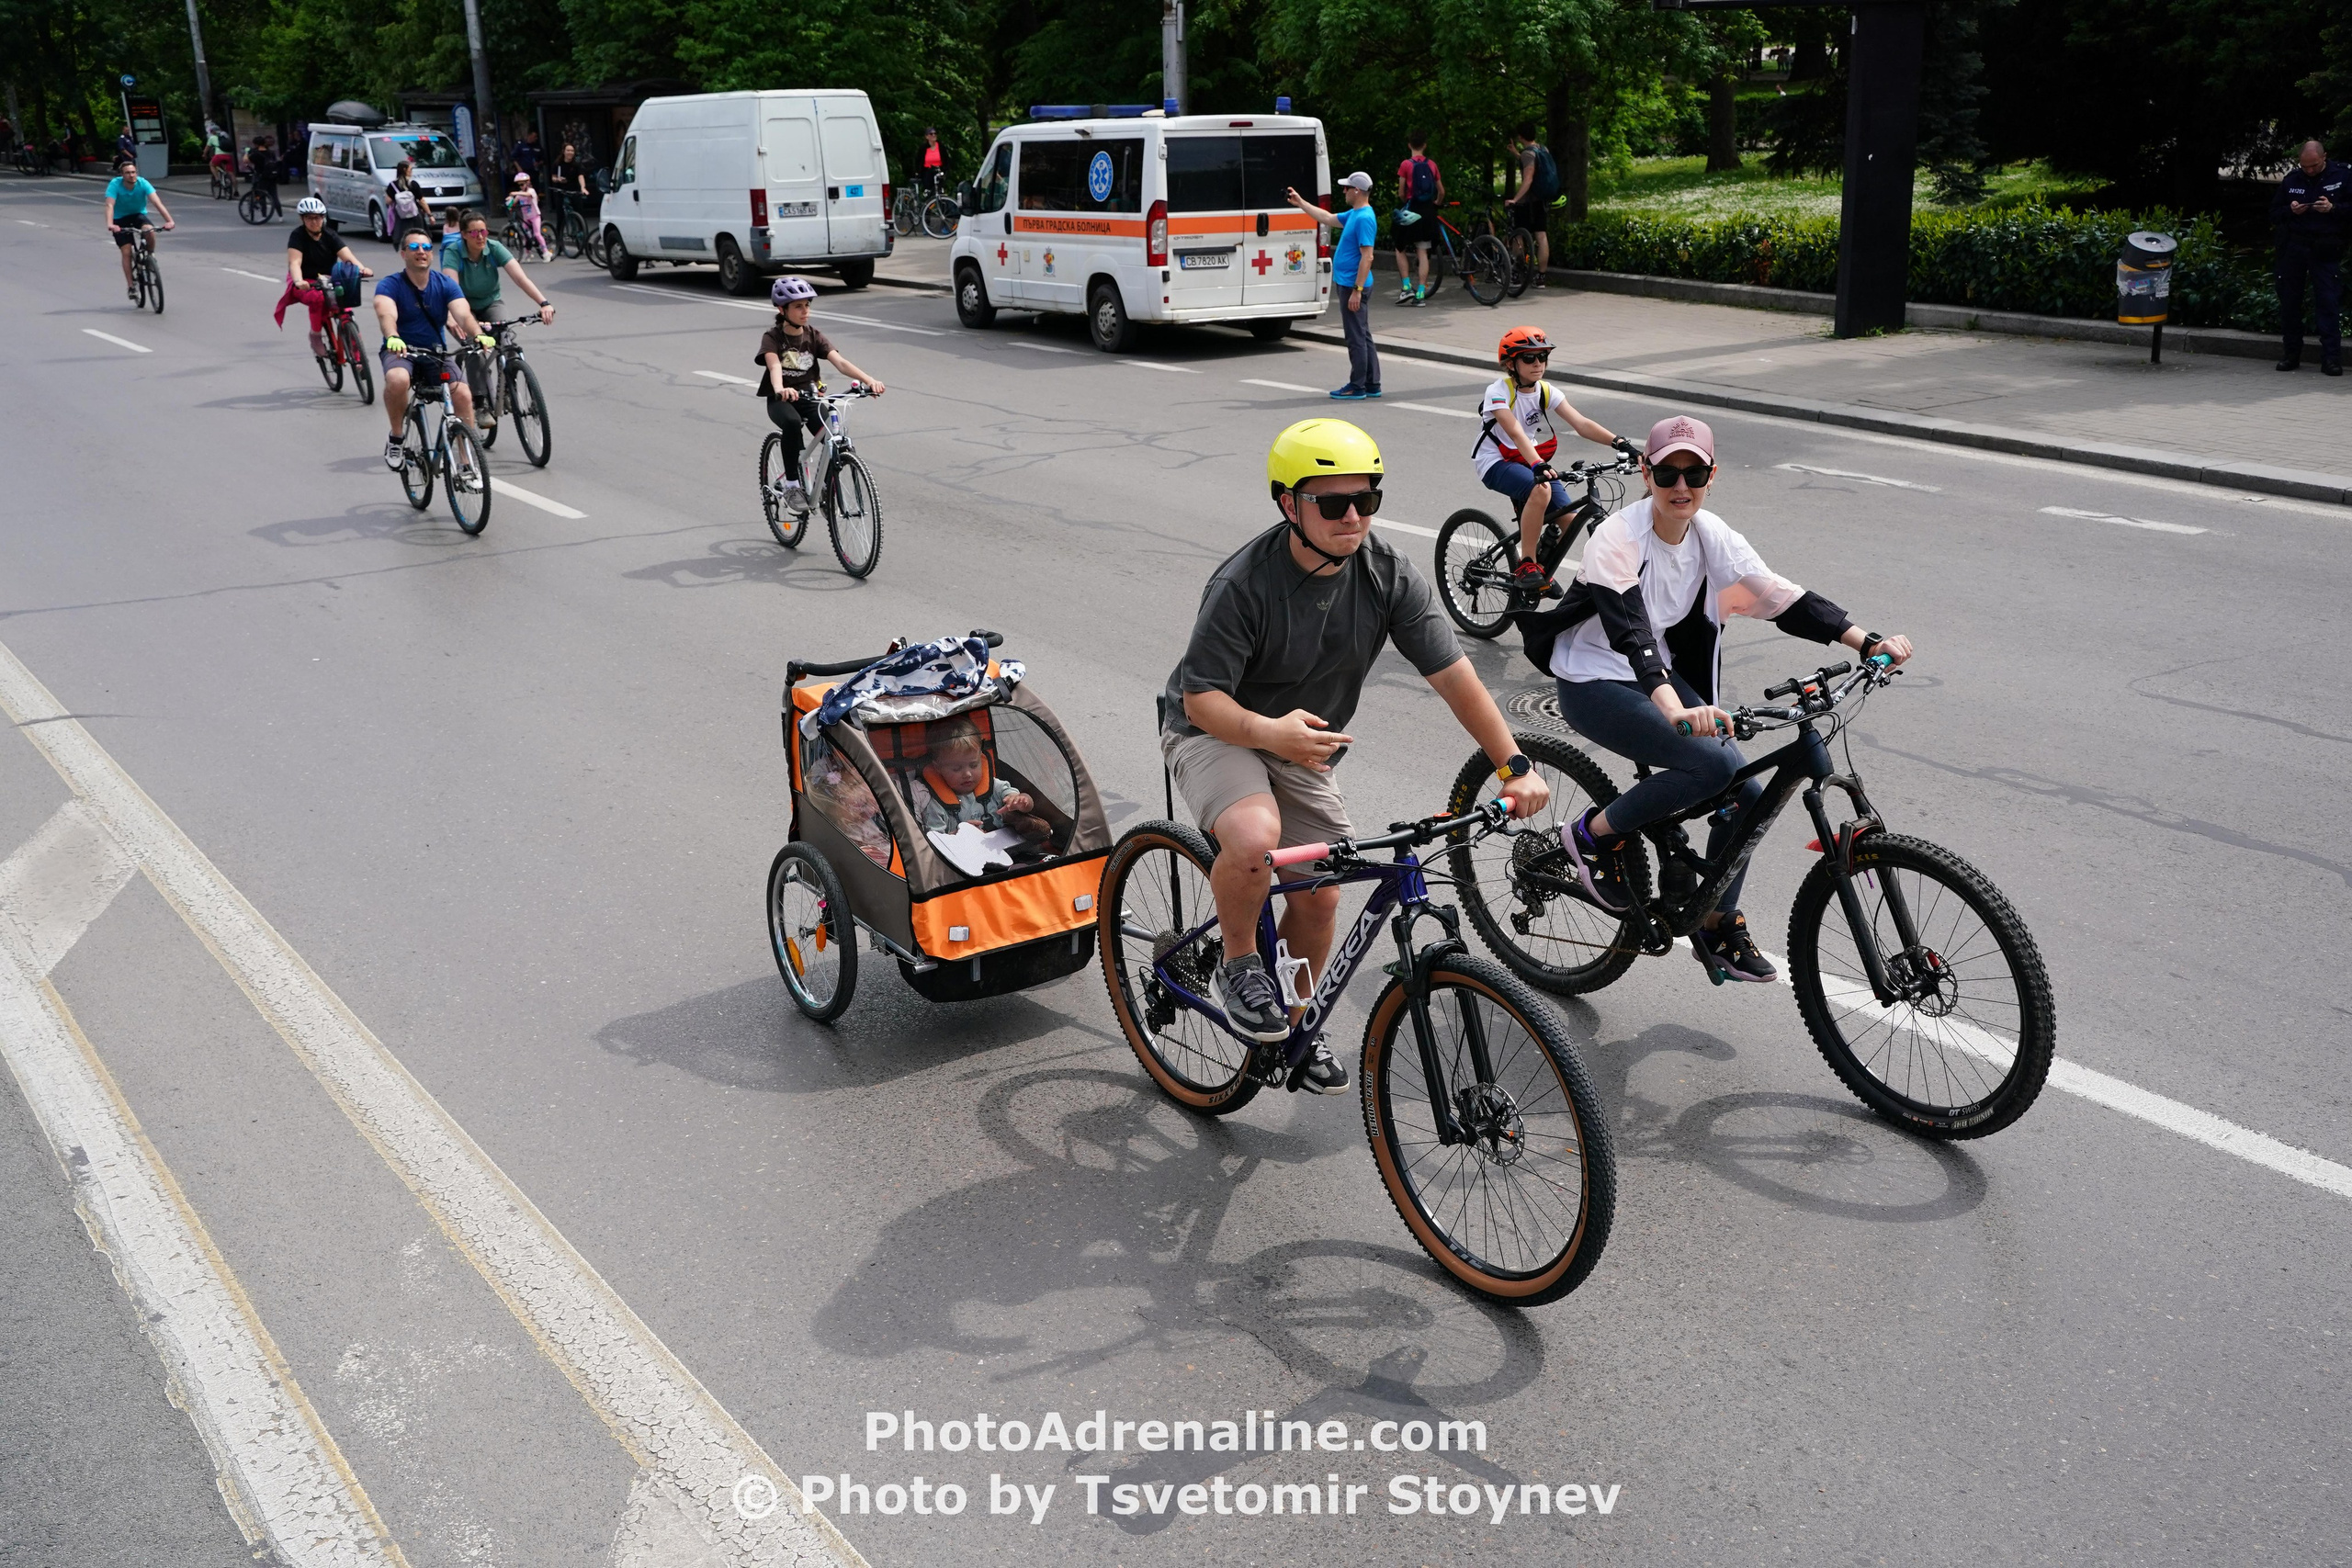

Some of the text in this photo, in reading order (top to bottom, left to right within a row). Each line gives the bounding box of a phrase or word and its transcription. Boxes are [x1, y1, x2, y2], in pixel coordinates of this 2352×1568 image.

[1023, 219, 1111, 234] ПЪРВА ГРАДСКА БОЛНИЦА
[1186, 255, 1227, 266] CB 7820 AK
[1302, 908, 1382, 1032] ORBEA
[1542, 964, 1552, 972] DT
[1365, 1069, 1374, 1099] RACE
[1949, 1102, 1981, 1117] DT SWISS
[1366, 1101, 1380, 1137] REKON
